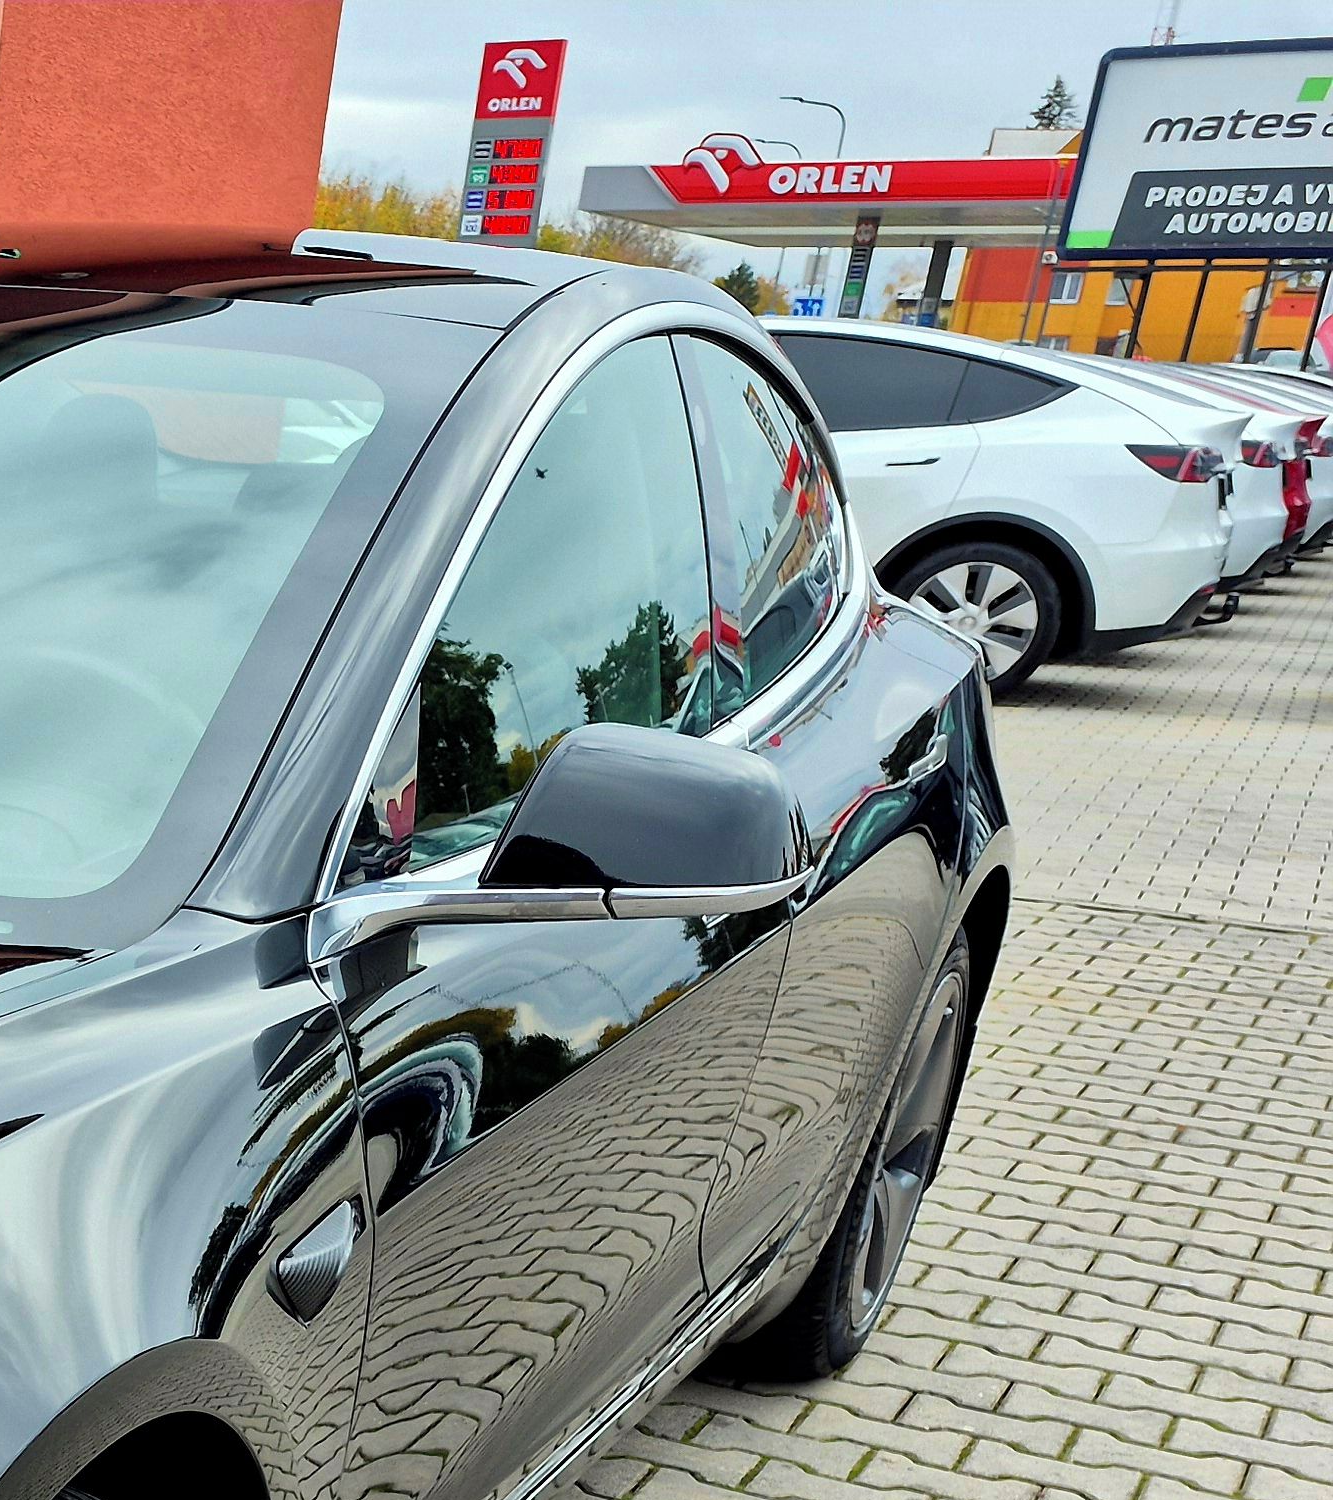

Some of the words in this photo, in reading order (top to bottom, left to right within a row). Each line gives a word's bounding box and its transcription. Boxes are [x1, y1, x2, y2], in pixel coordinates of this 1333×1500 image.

[488, 96, 542, 112] ORLEN
[1144, 109, 1317, 143] mates
[768, 164, 893, 194] ORLEN
[1145, 184, 1270, 208] PRODEJ
[1272, 184, 1294, 206] A
